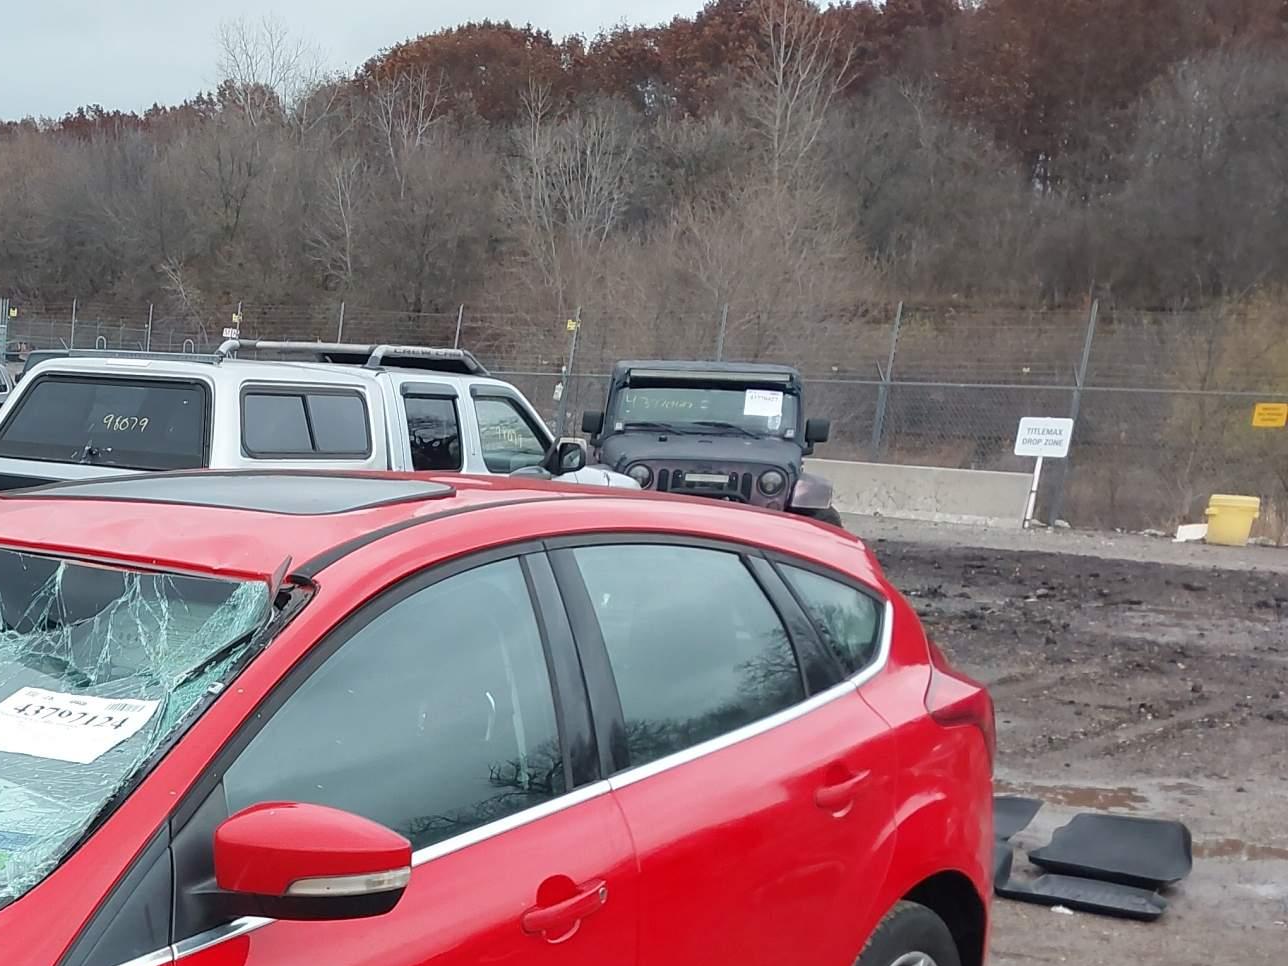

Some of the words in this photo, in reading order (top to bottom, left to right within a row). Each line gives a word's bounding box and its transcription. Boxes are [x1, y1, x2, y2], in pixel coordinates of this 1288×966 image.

[1027, 427, 1064, 436] TITLEMAX
[1022, 438, 1043, 446] DROP
[1043, 439, 1064, 447] ZONE
